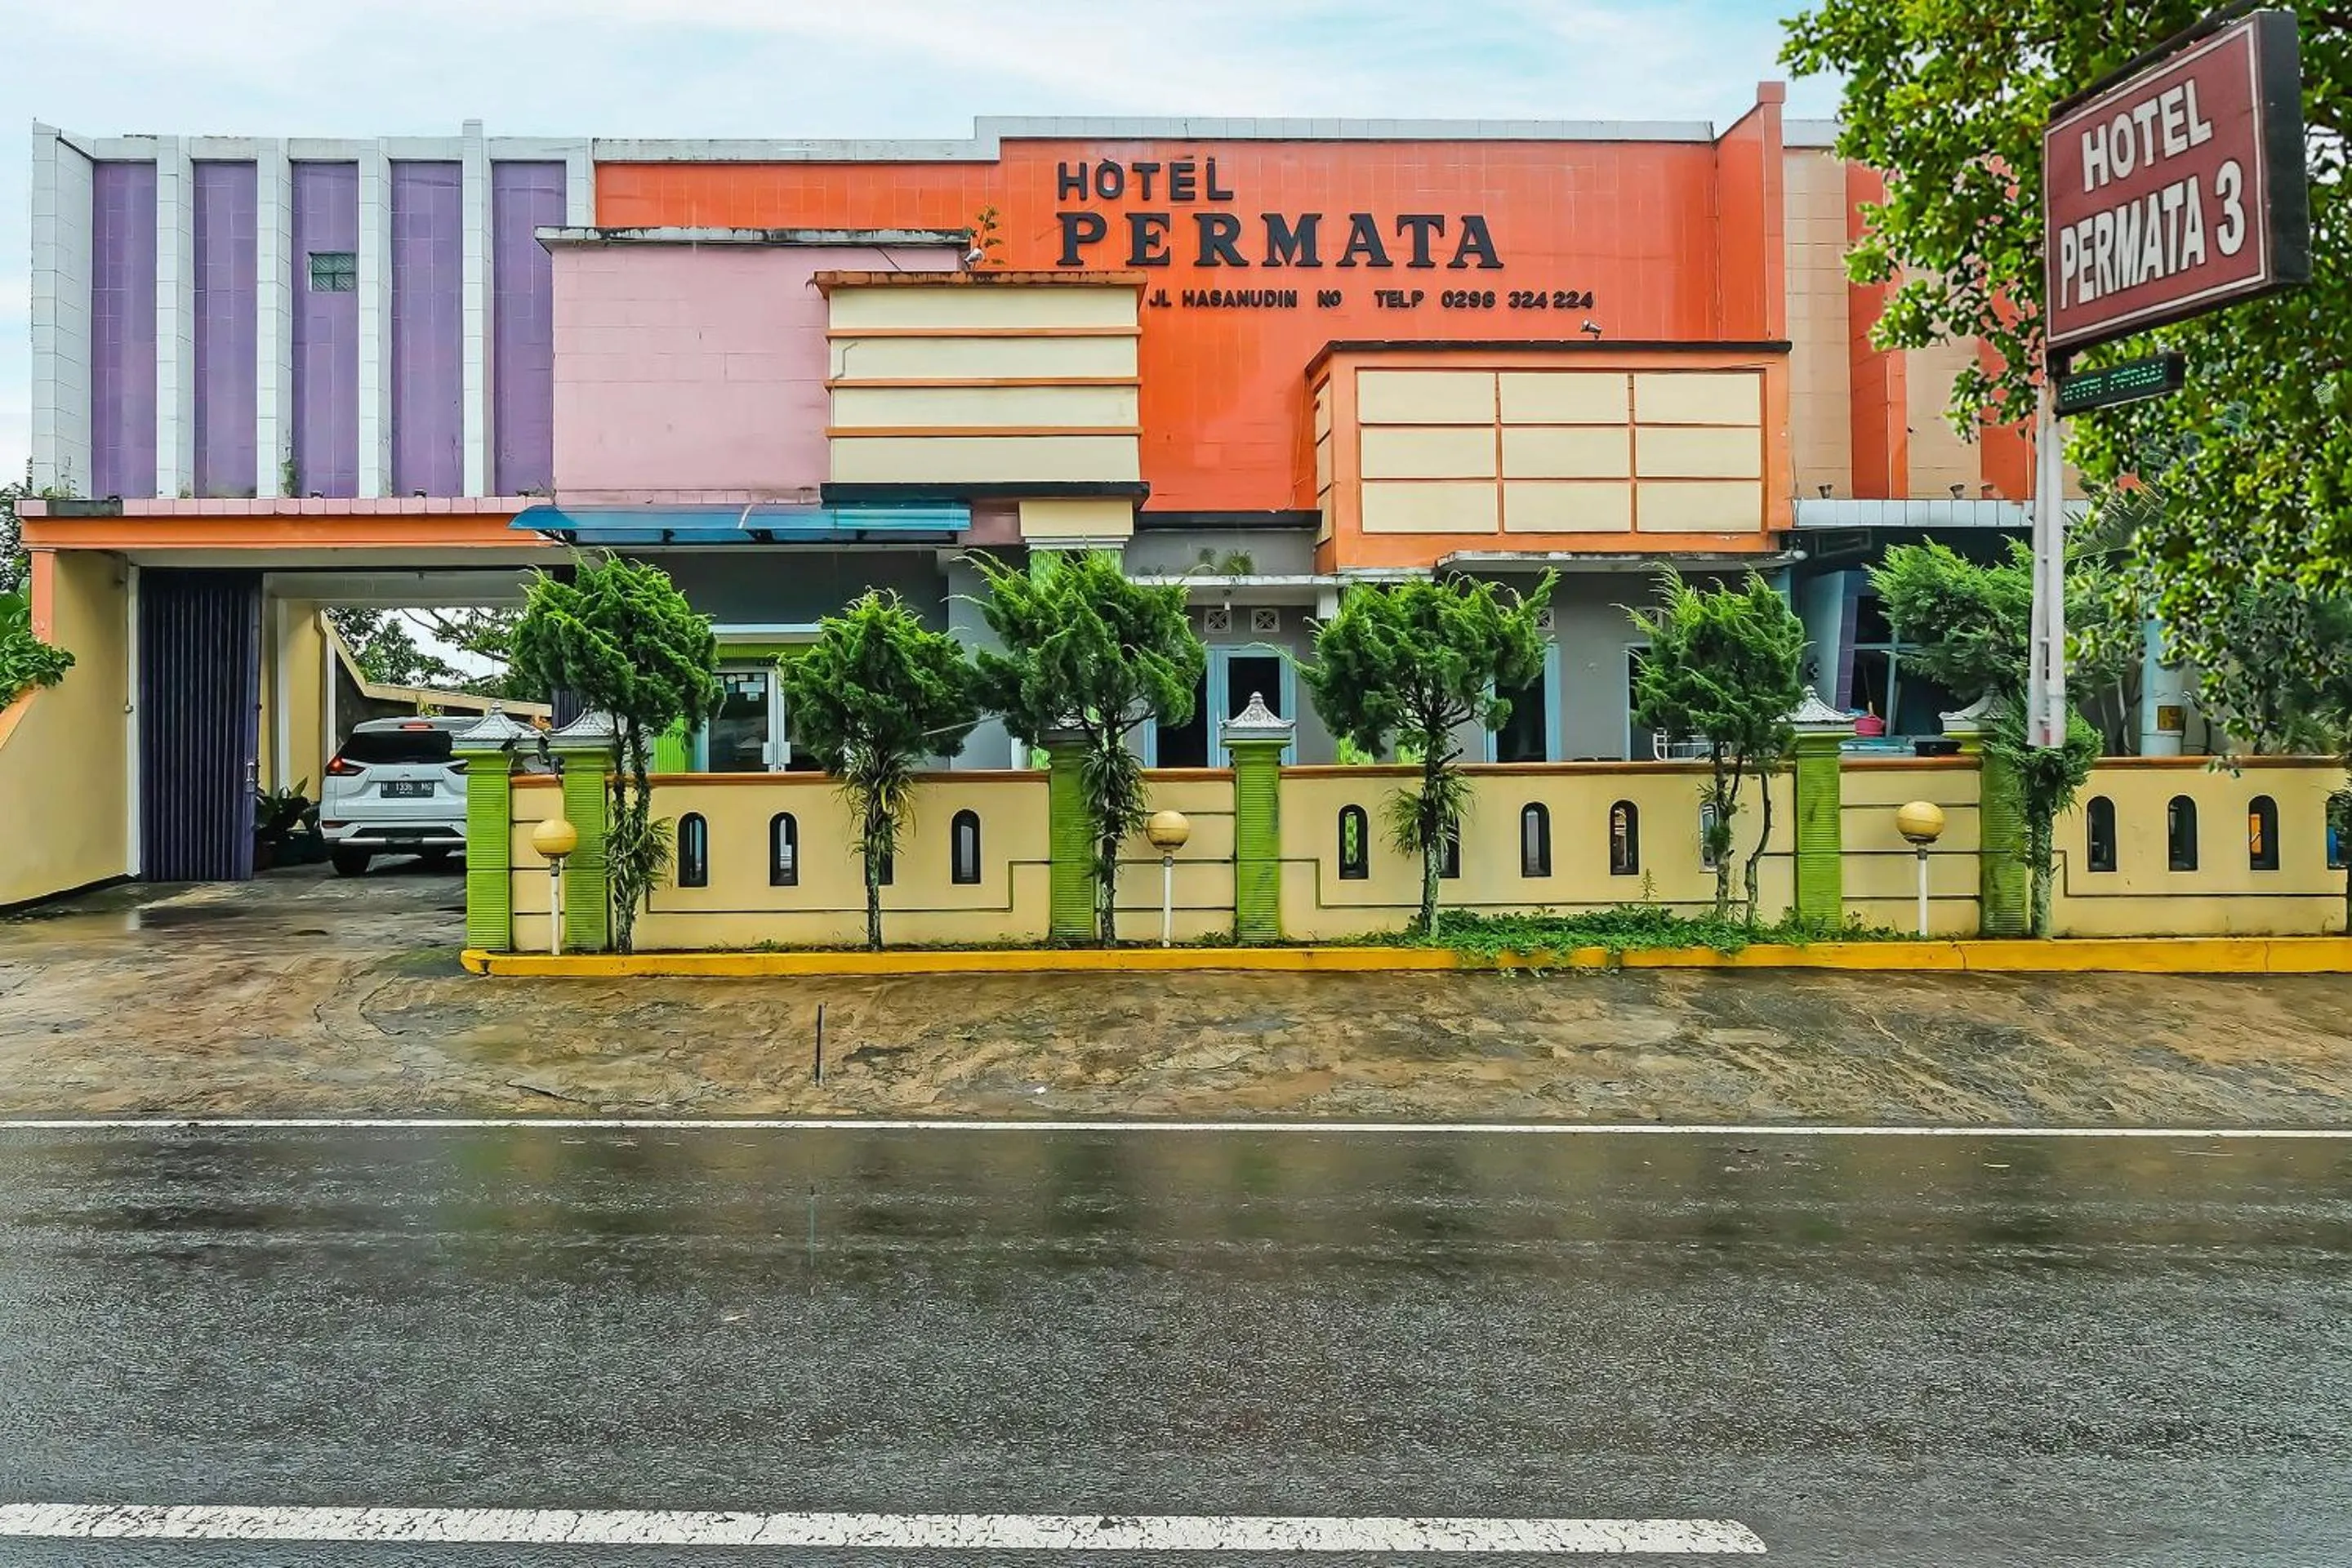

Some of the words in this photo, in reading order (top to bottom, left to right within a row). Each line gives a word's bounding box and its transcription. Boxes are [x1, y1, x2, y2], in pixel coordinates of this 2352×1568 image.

[2082, 78, 2213, 193] HOTEL
[1058, 158, 1234, 202] HOTEL
[1056, 212, 1508, 268] PERMATA
[2060, 174, 2206, 310] PERMATA
[2216, 160, 2245, 256] 3
[1148, 289, 1173, 308] JL
[1182, 289, 1298, 308] HASANUDIN
[1317, 290, 1343, 308] NO
[1374, 290, 1424, 308] TELP
[1508, 291, 1548, 309] 324
[1553, 291, 1594, 310] 224
